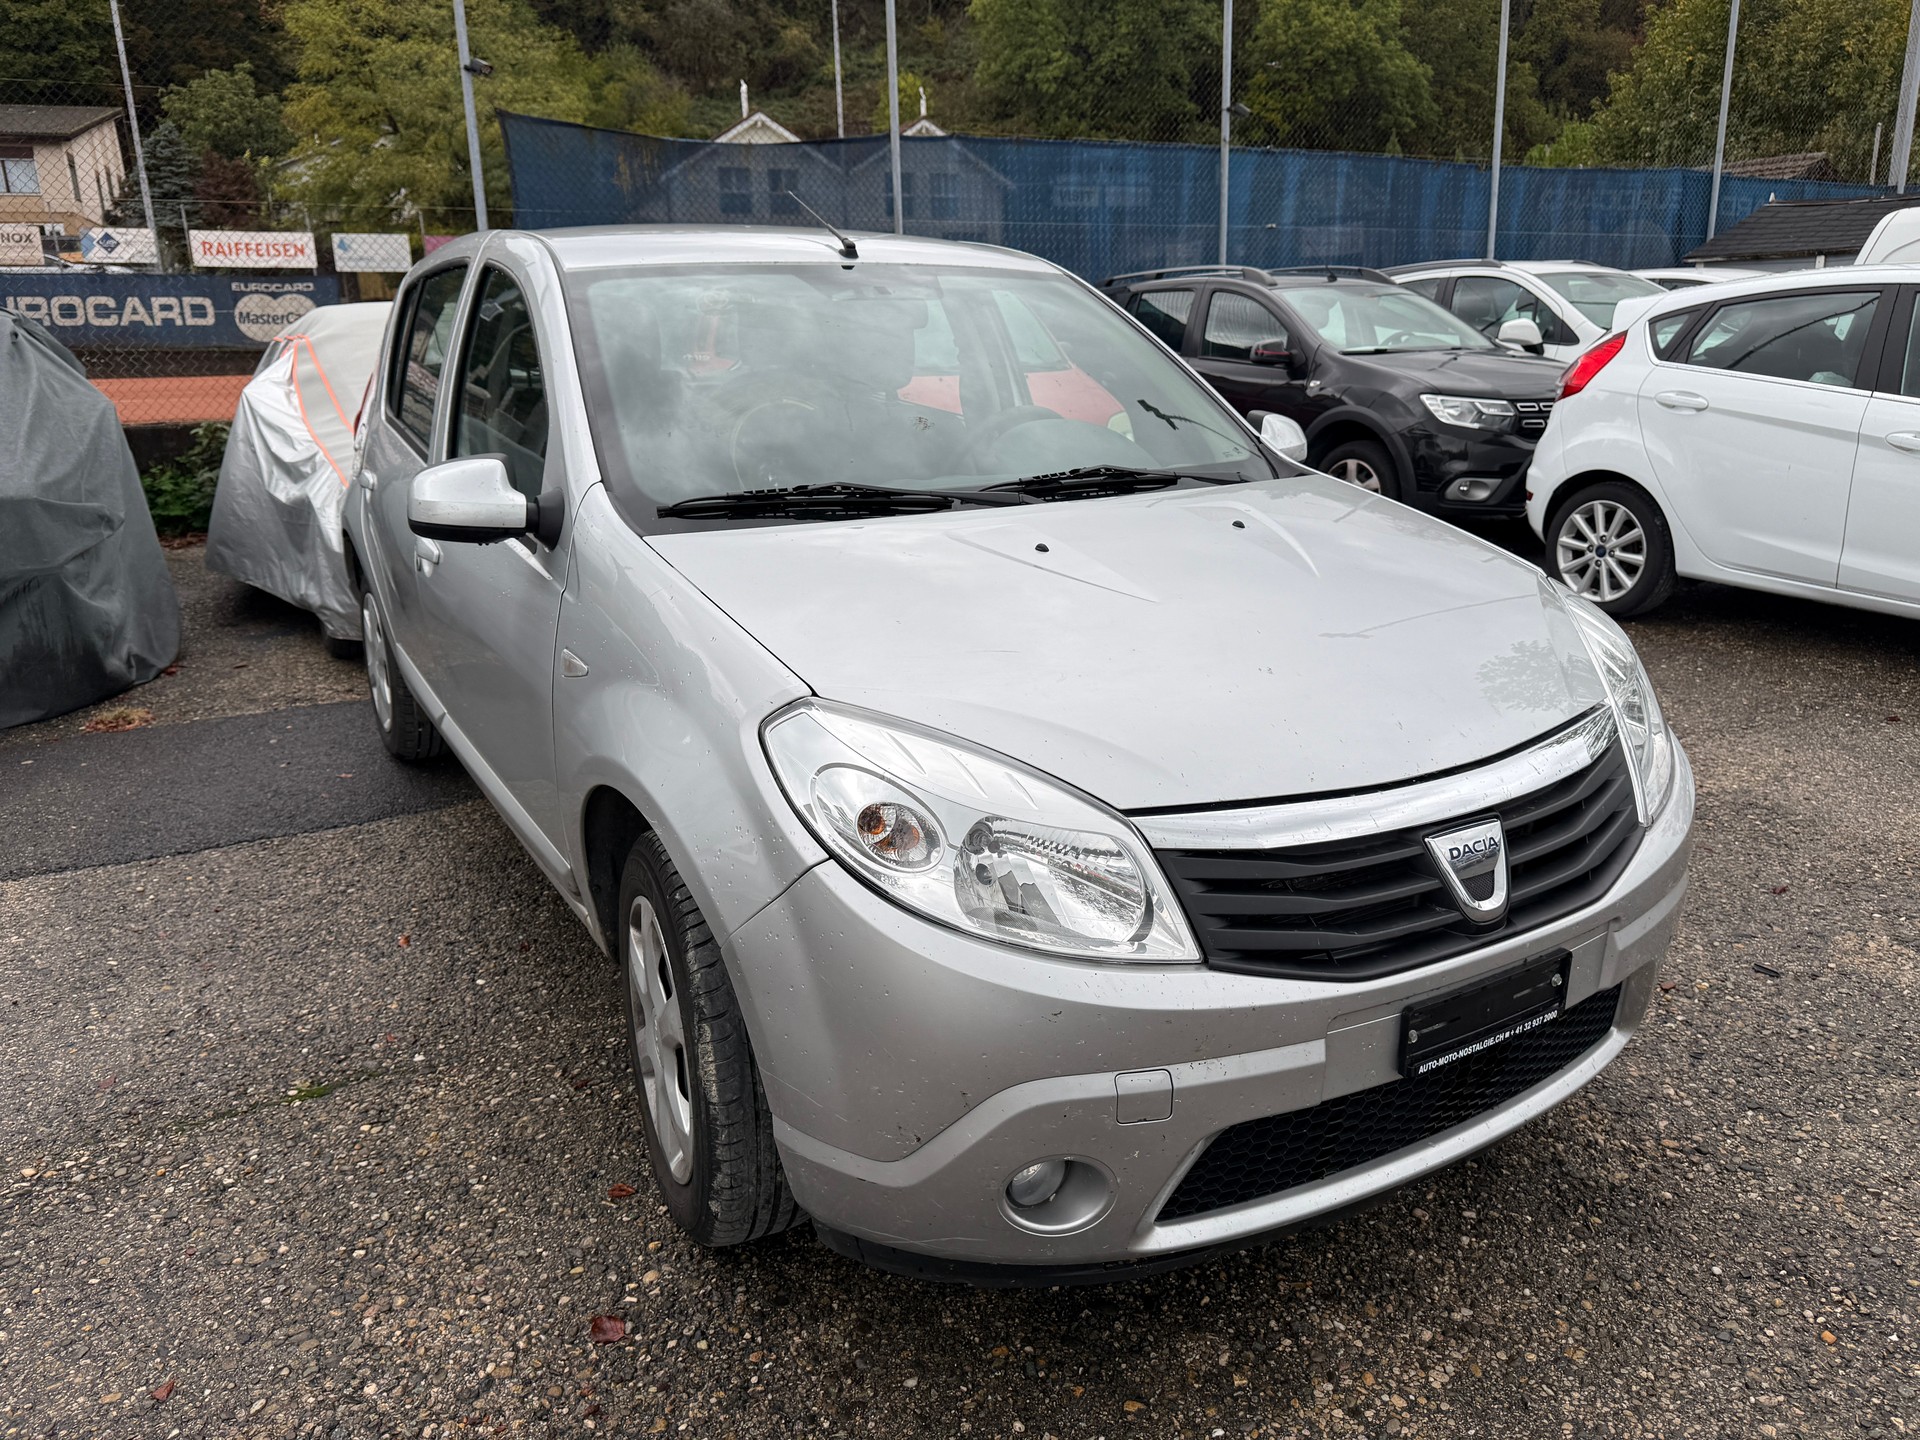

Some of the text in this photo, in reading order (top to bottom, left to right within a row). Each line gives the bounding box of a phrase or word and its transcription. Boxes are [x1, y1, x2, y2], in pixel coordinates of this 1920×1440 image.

[201, 240, 305, 257] RAIFFEISEN
[231, 282, 314, 293] EUROCARD
[5, 296, 216, 327] ROCARD
[1448, 836, 1499, 860] DACIA
[1418, 1032, 1505, 1074] AUTO-MOTO-NOSTALGIE.CH
[1515, 1024, 1523, 1035] 41
[1523, 1020, 1532, 1031] 32
[1532, 1016, 1543, 1028] 937
[1543, 1010, 1558, 1022] 2000
